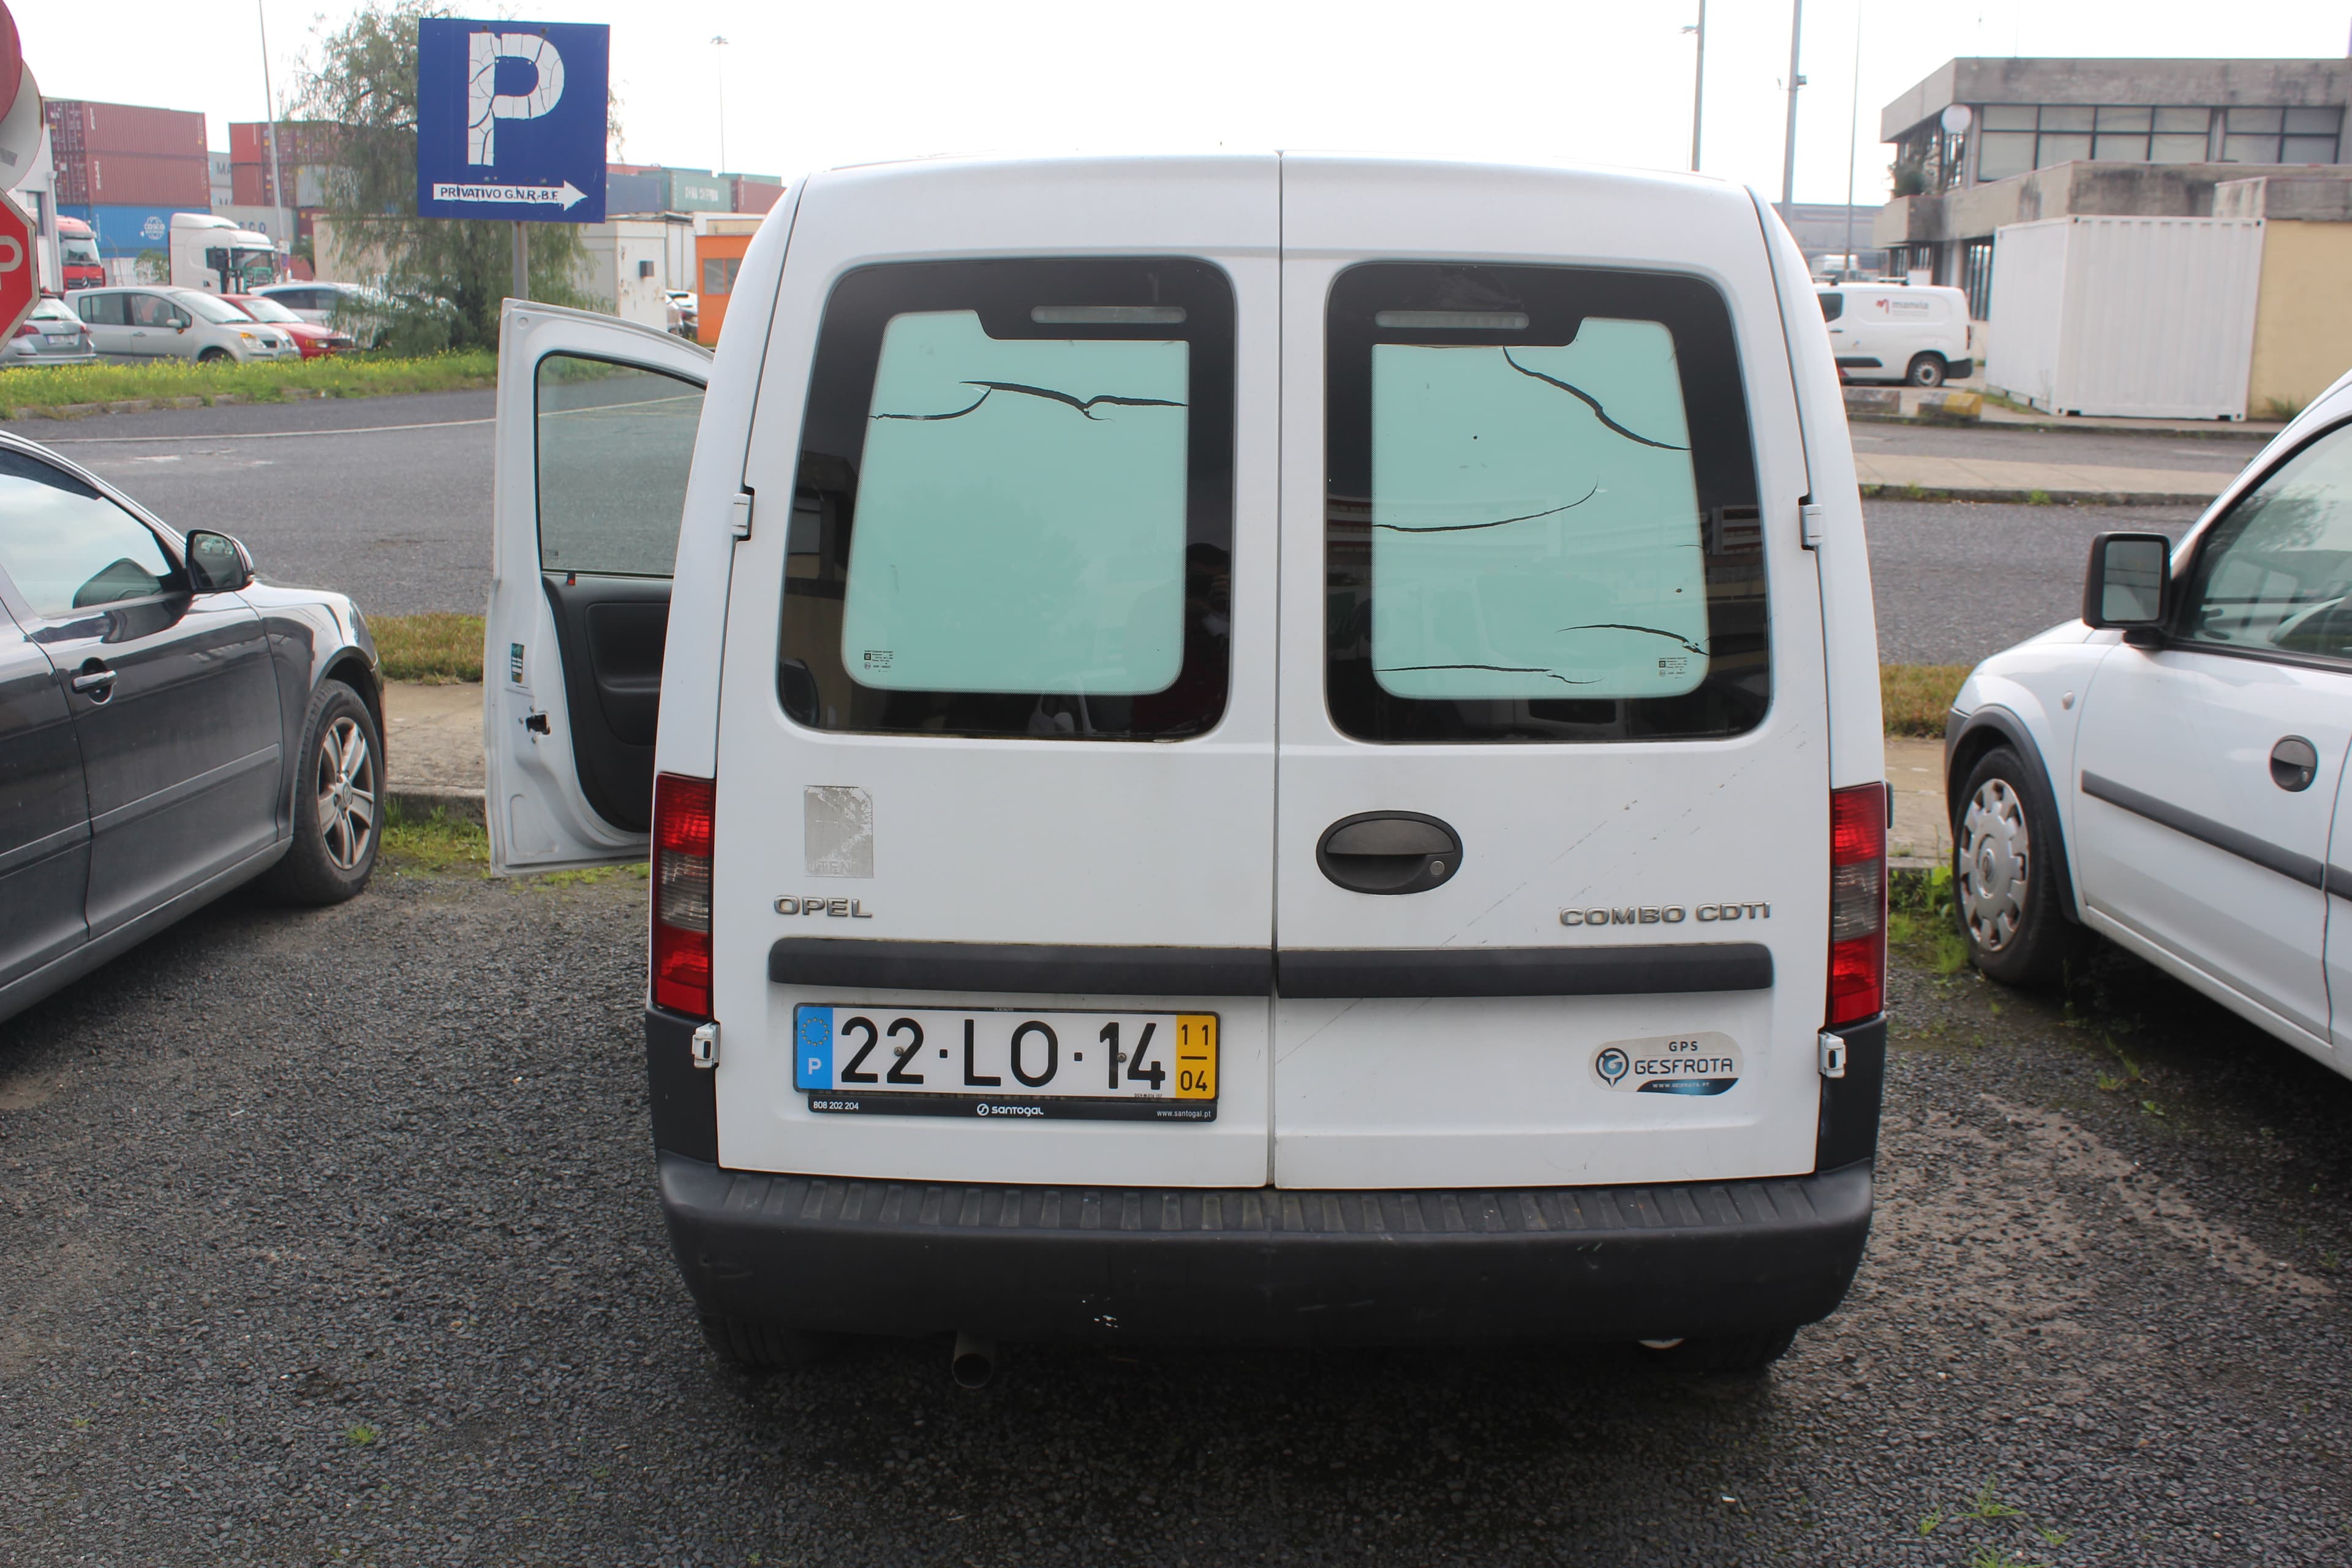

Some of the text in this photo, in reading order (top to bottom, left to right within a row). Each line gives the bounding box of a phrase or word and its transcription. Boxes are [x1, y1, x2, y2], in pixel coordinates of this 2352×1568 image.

[468, 32, 565, 166] P
[440, 187, 501, 198] PRIVATIVO
[774, 895, 873, 918] OPEL
[1560, 901, 1771, 926] COMBO CDTI
[1181, 1023, 1209, 1046] 11
[1668, 1041, 1699, 1052] GPS
[808, 1057, 822, 1075] P
[1634, 1058, 1733, 1075] GESFROTA
[1180, 1070, 1208, 1092] 04
[813, 1101, 859, 1110] 808 202 204
[1156, 1110, 1211, 1118] www.santogal.pt
